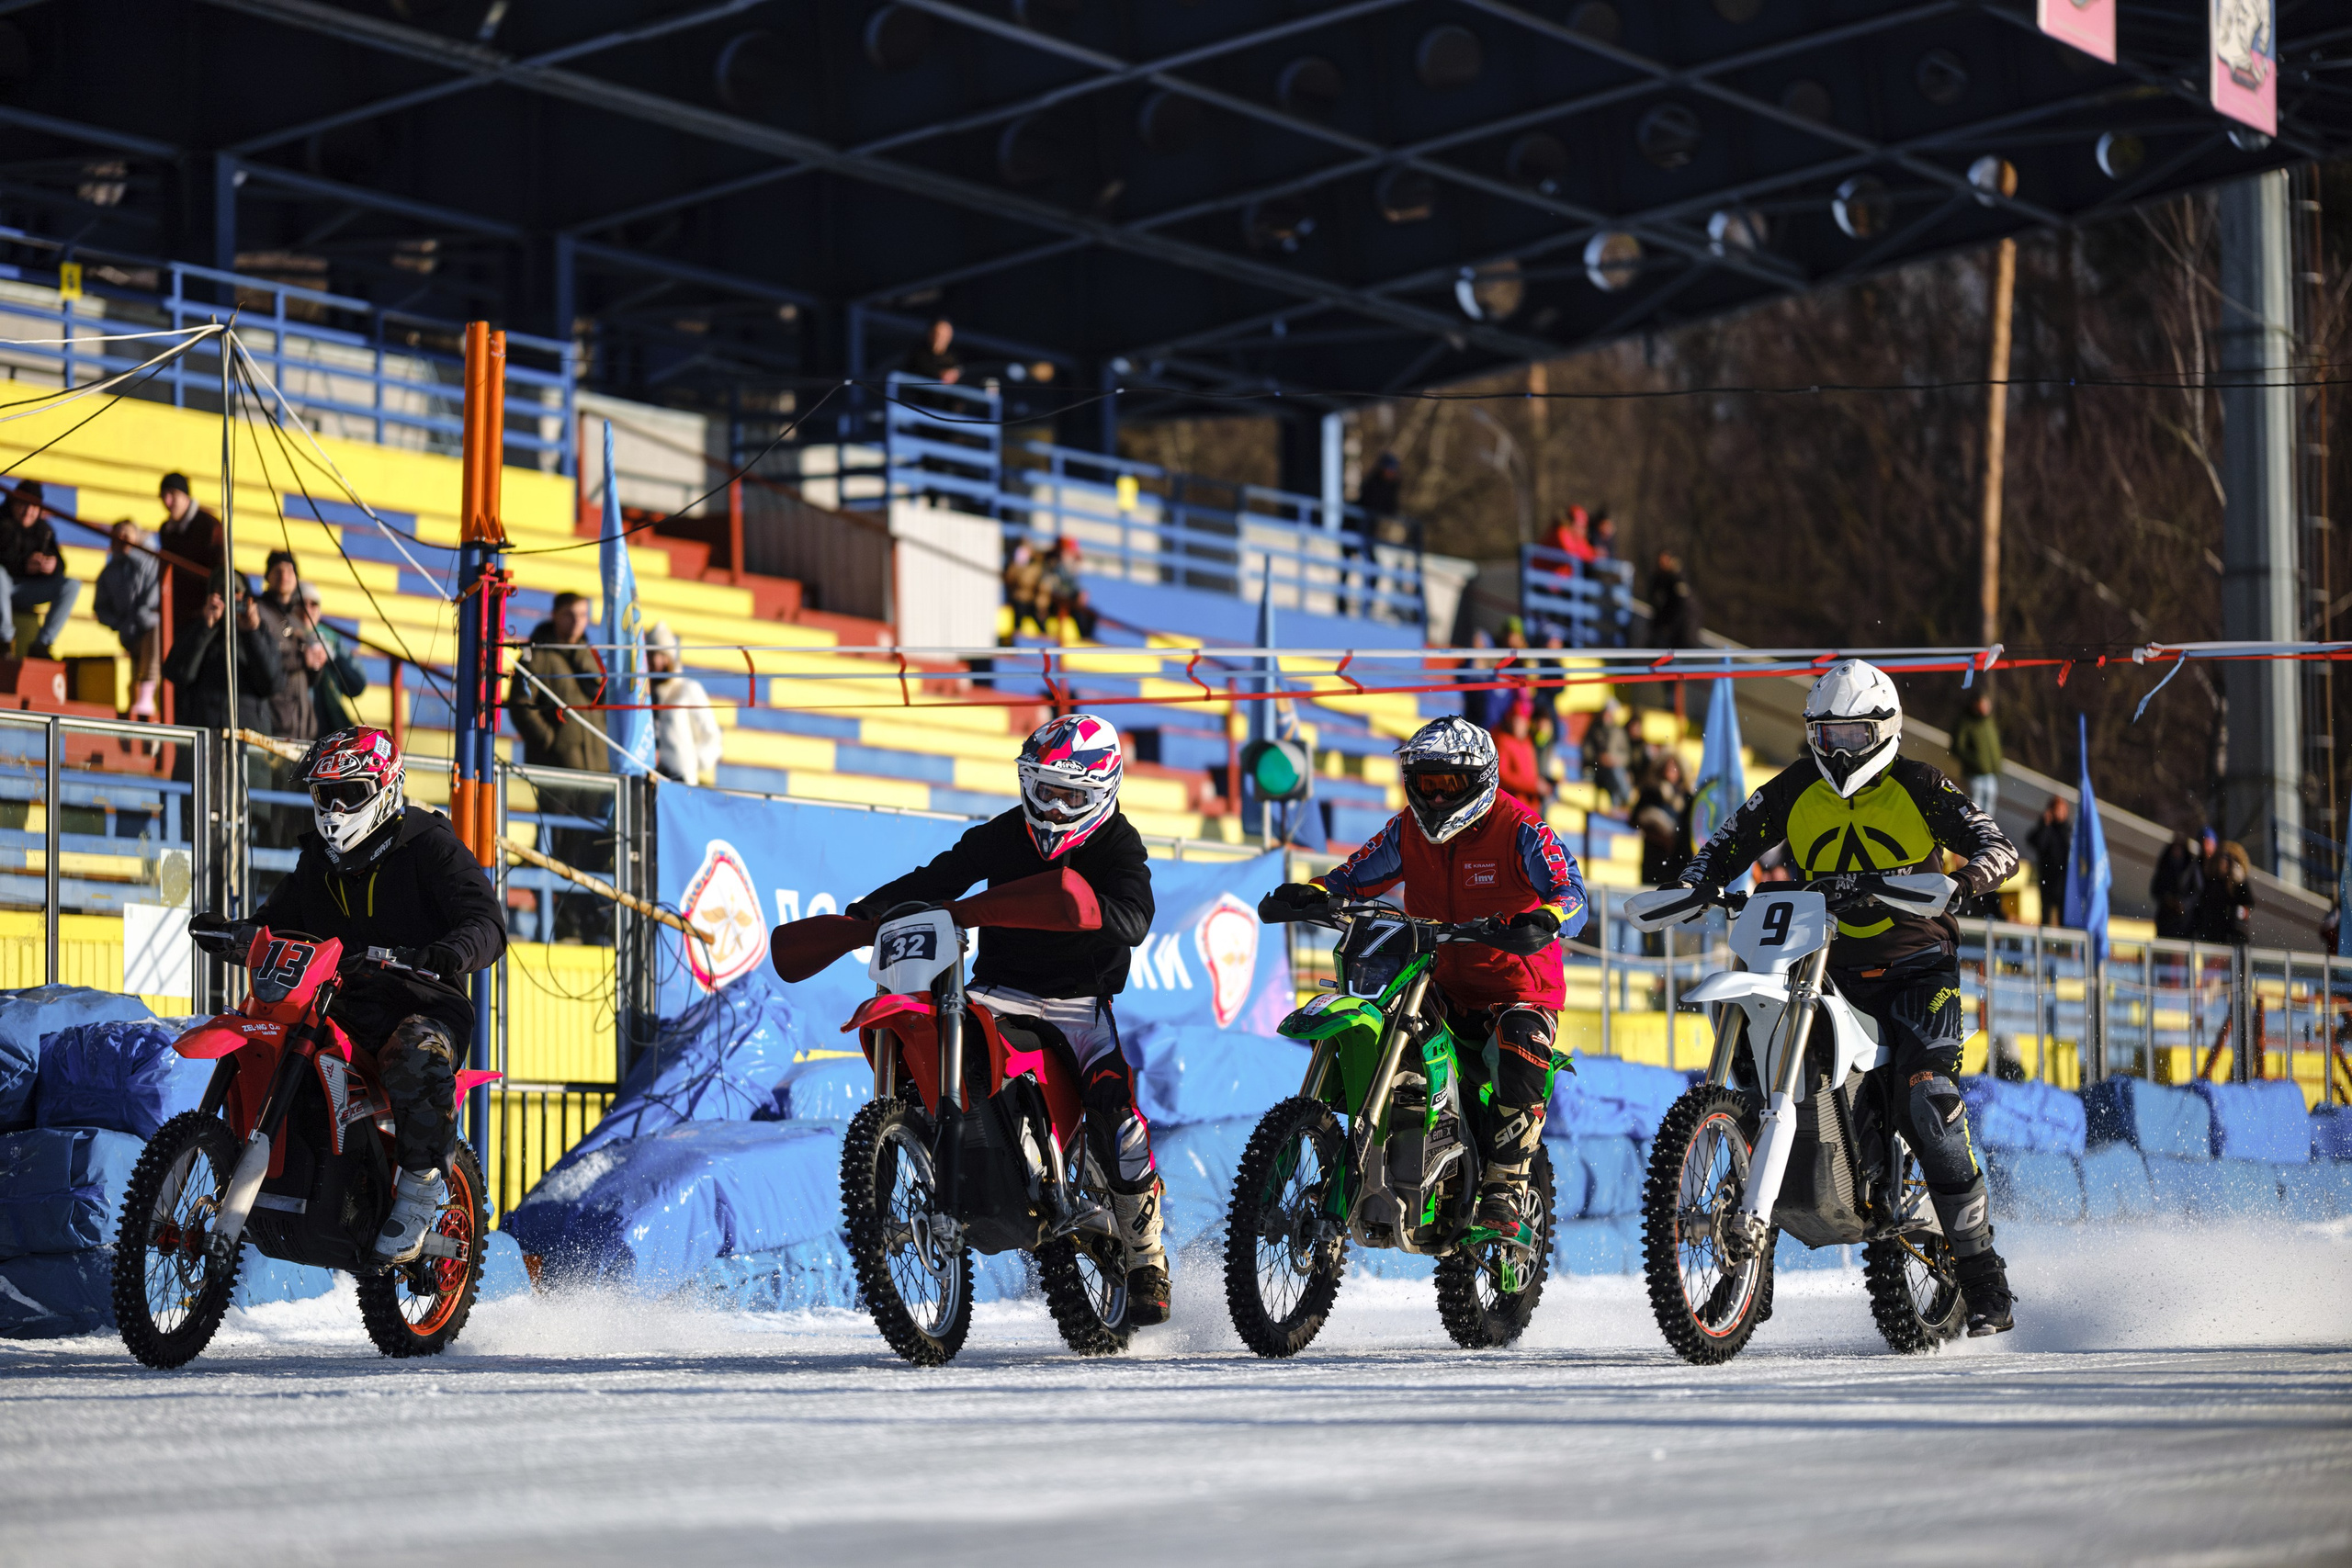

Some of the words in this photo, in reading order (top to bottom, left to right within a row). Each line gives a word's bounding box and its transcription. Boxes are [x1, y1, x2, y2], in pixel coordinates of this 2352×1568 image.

[1358, 918, 1408, 958] 7
[1758, 901, 1795, 947] 9
[257, 940, 316, 989] 13
[891, 934, 925, 960] 32
[1385, 962, 1422, 999] ELECTRO
[341, 1103, 364, 1120] EXE
[1494, 1111, 1530, 1150] SIDI
[1131, 1194, 1155, 1235] SIDI
